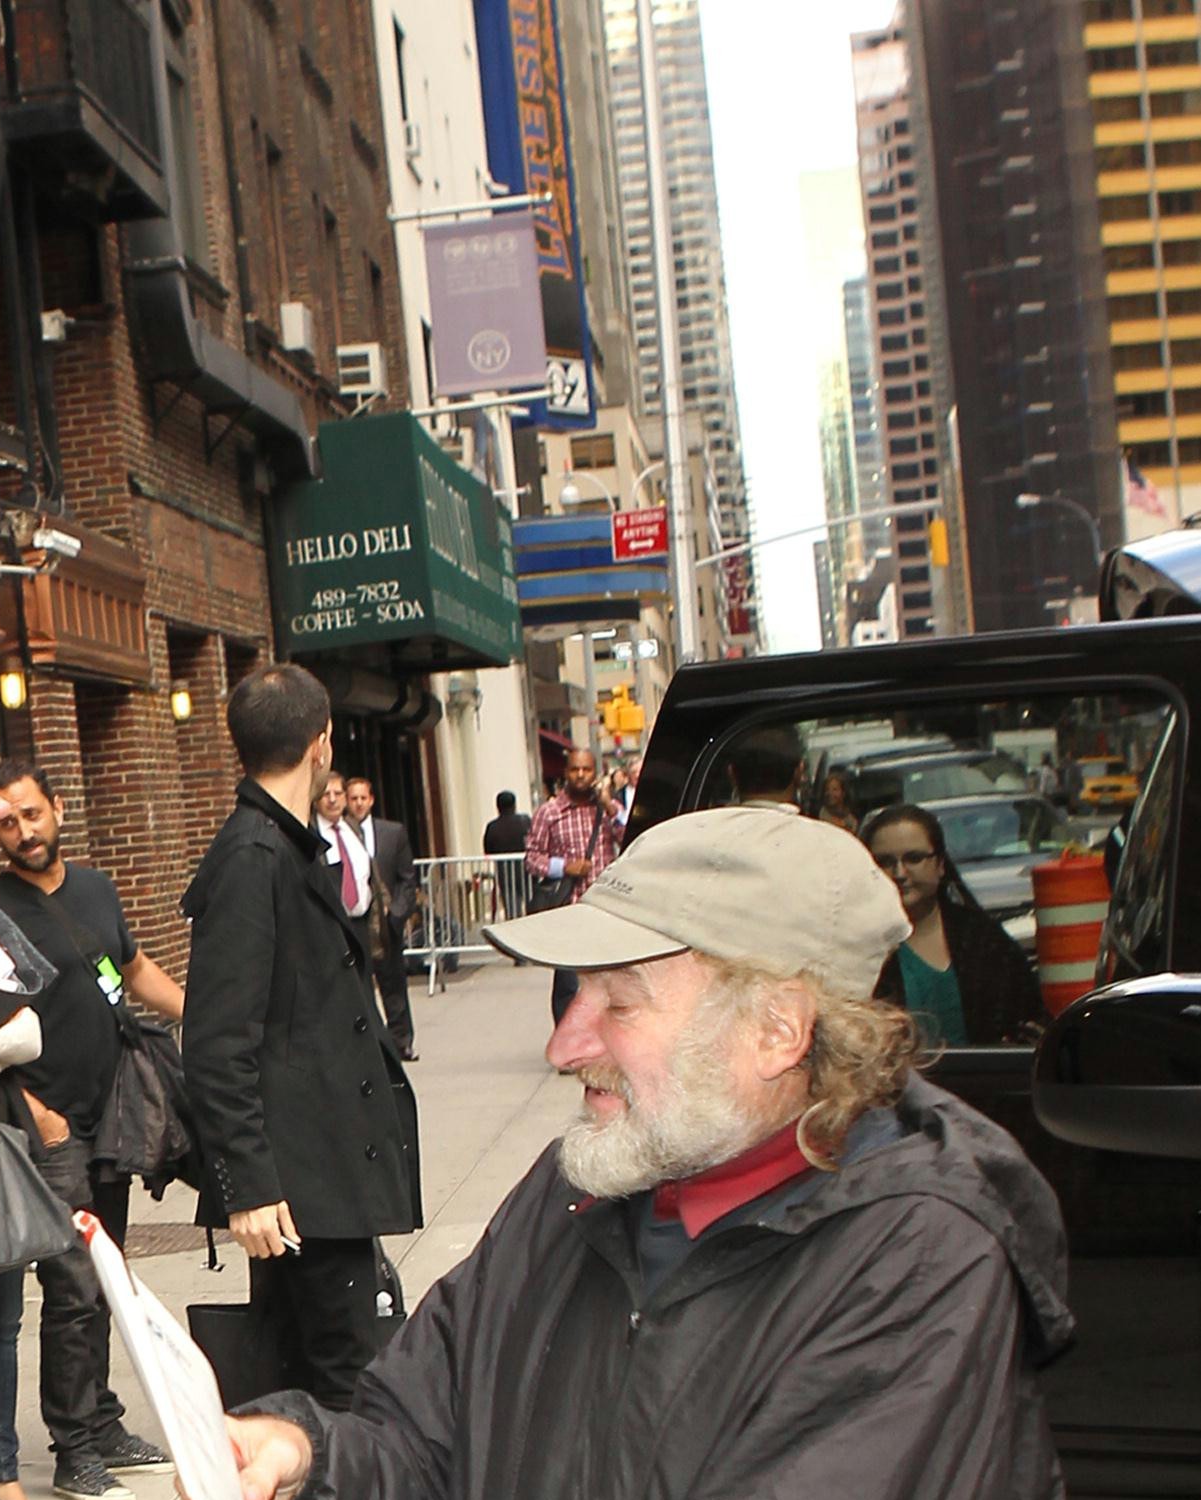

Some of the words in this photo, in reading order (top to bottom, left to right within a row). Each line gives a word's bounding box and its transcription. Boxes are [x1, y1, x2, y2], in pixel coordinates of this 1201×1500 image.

[509, 0, 544, 98] SH
[286, 533, 358, 566] HELLO
[363, 524, 411, 556] DELI
[622, 523, 660, 539] ANYTIME
[312, 580, 401, 610] 489-7832
[291, 608, 358, 634] COFFEE
[376, 599, 425, 624] SODA
